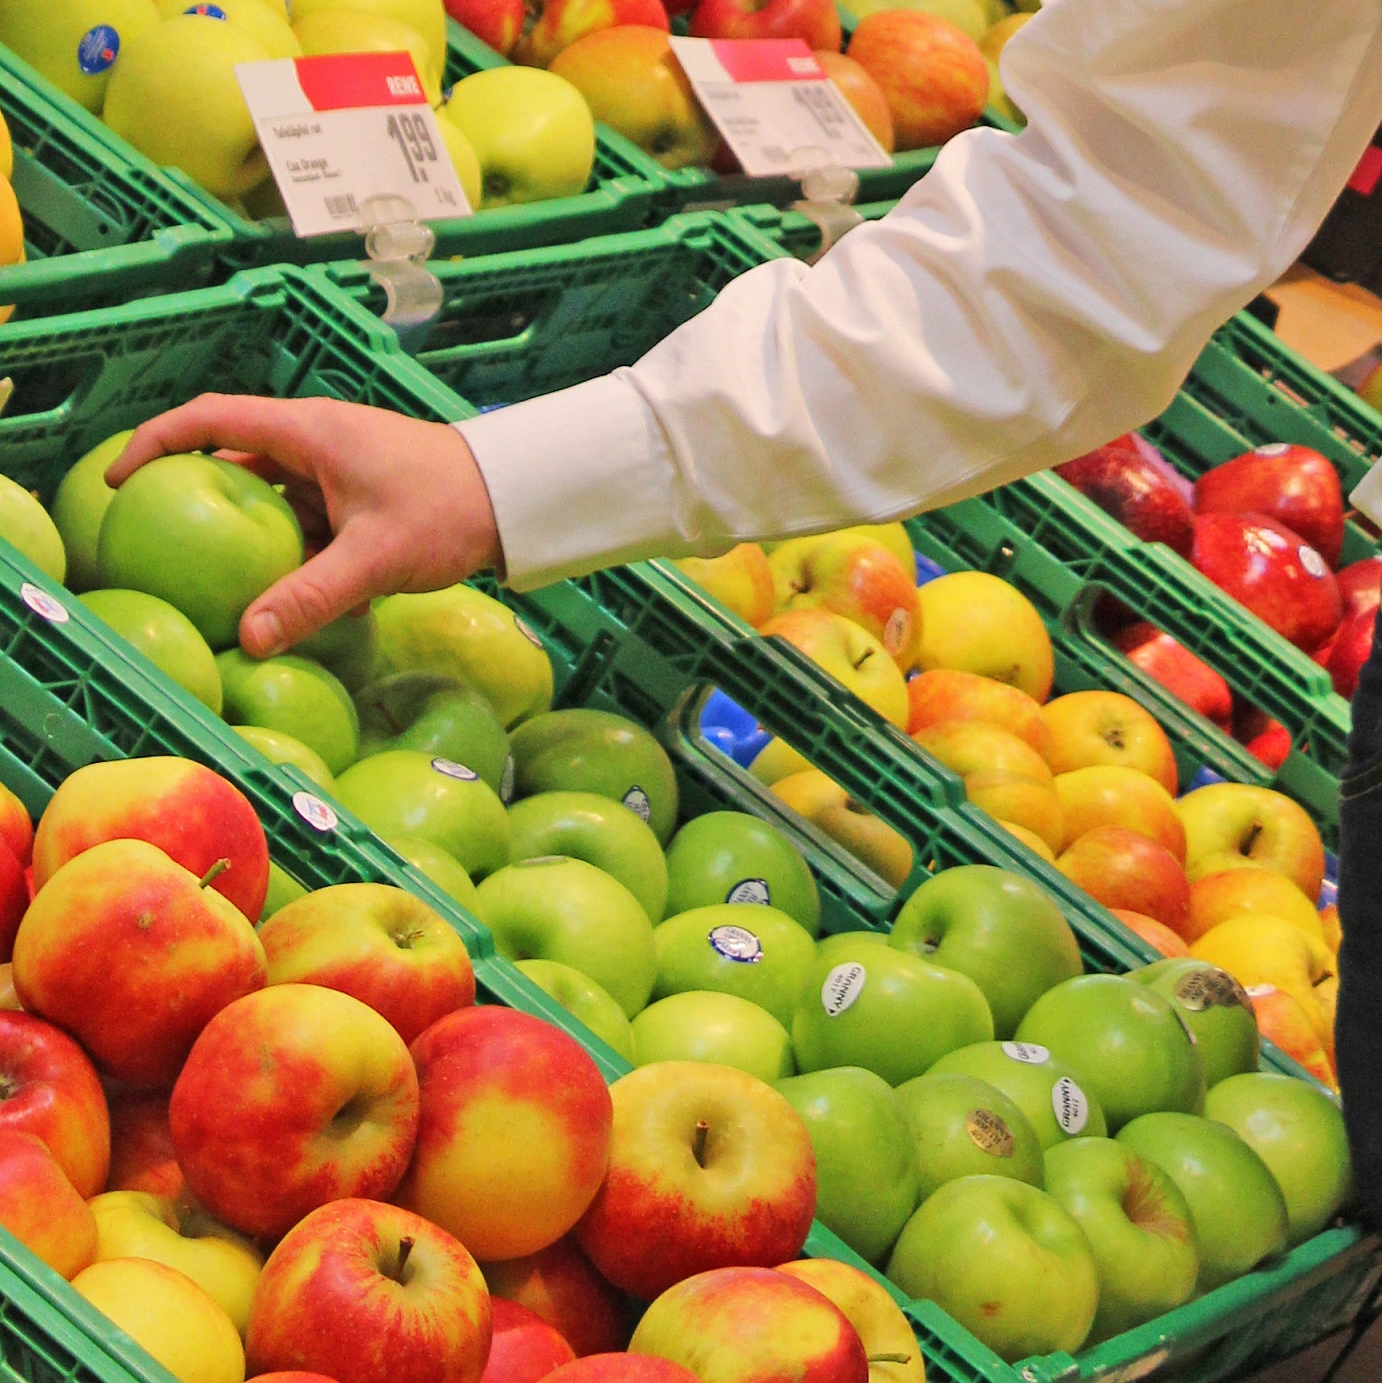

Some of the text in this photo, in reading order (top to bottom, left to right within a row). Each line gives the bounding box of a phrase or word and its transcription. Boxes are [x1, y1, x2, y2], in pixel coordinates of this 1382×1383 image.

[386, 75, 420, 95] REWE
[831, 974, 843, 992] 4017
[834, 966, 861, 1009] GRANNY
[1060, 1082, 1071, 1127] GRANNY
